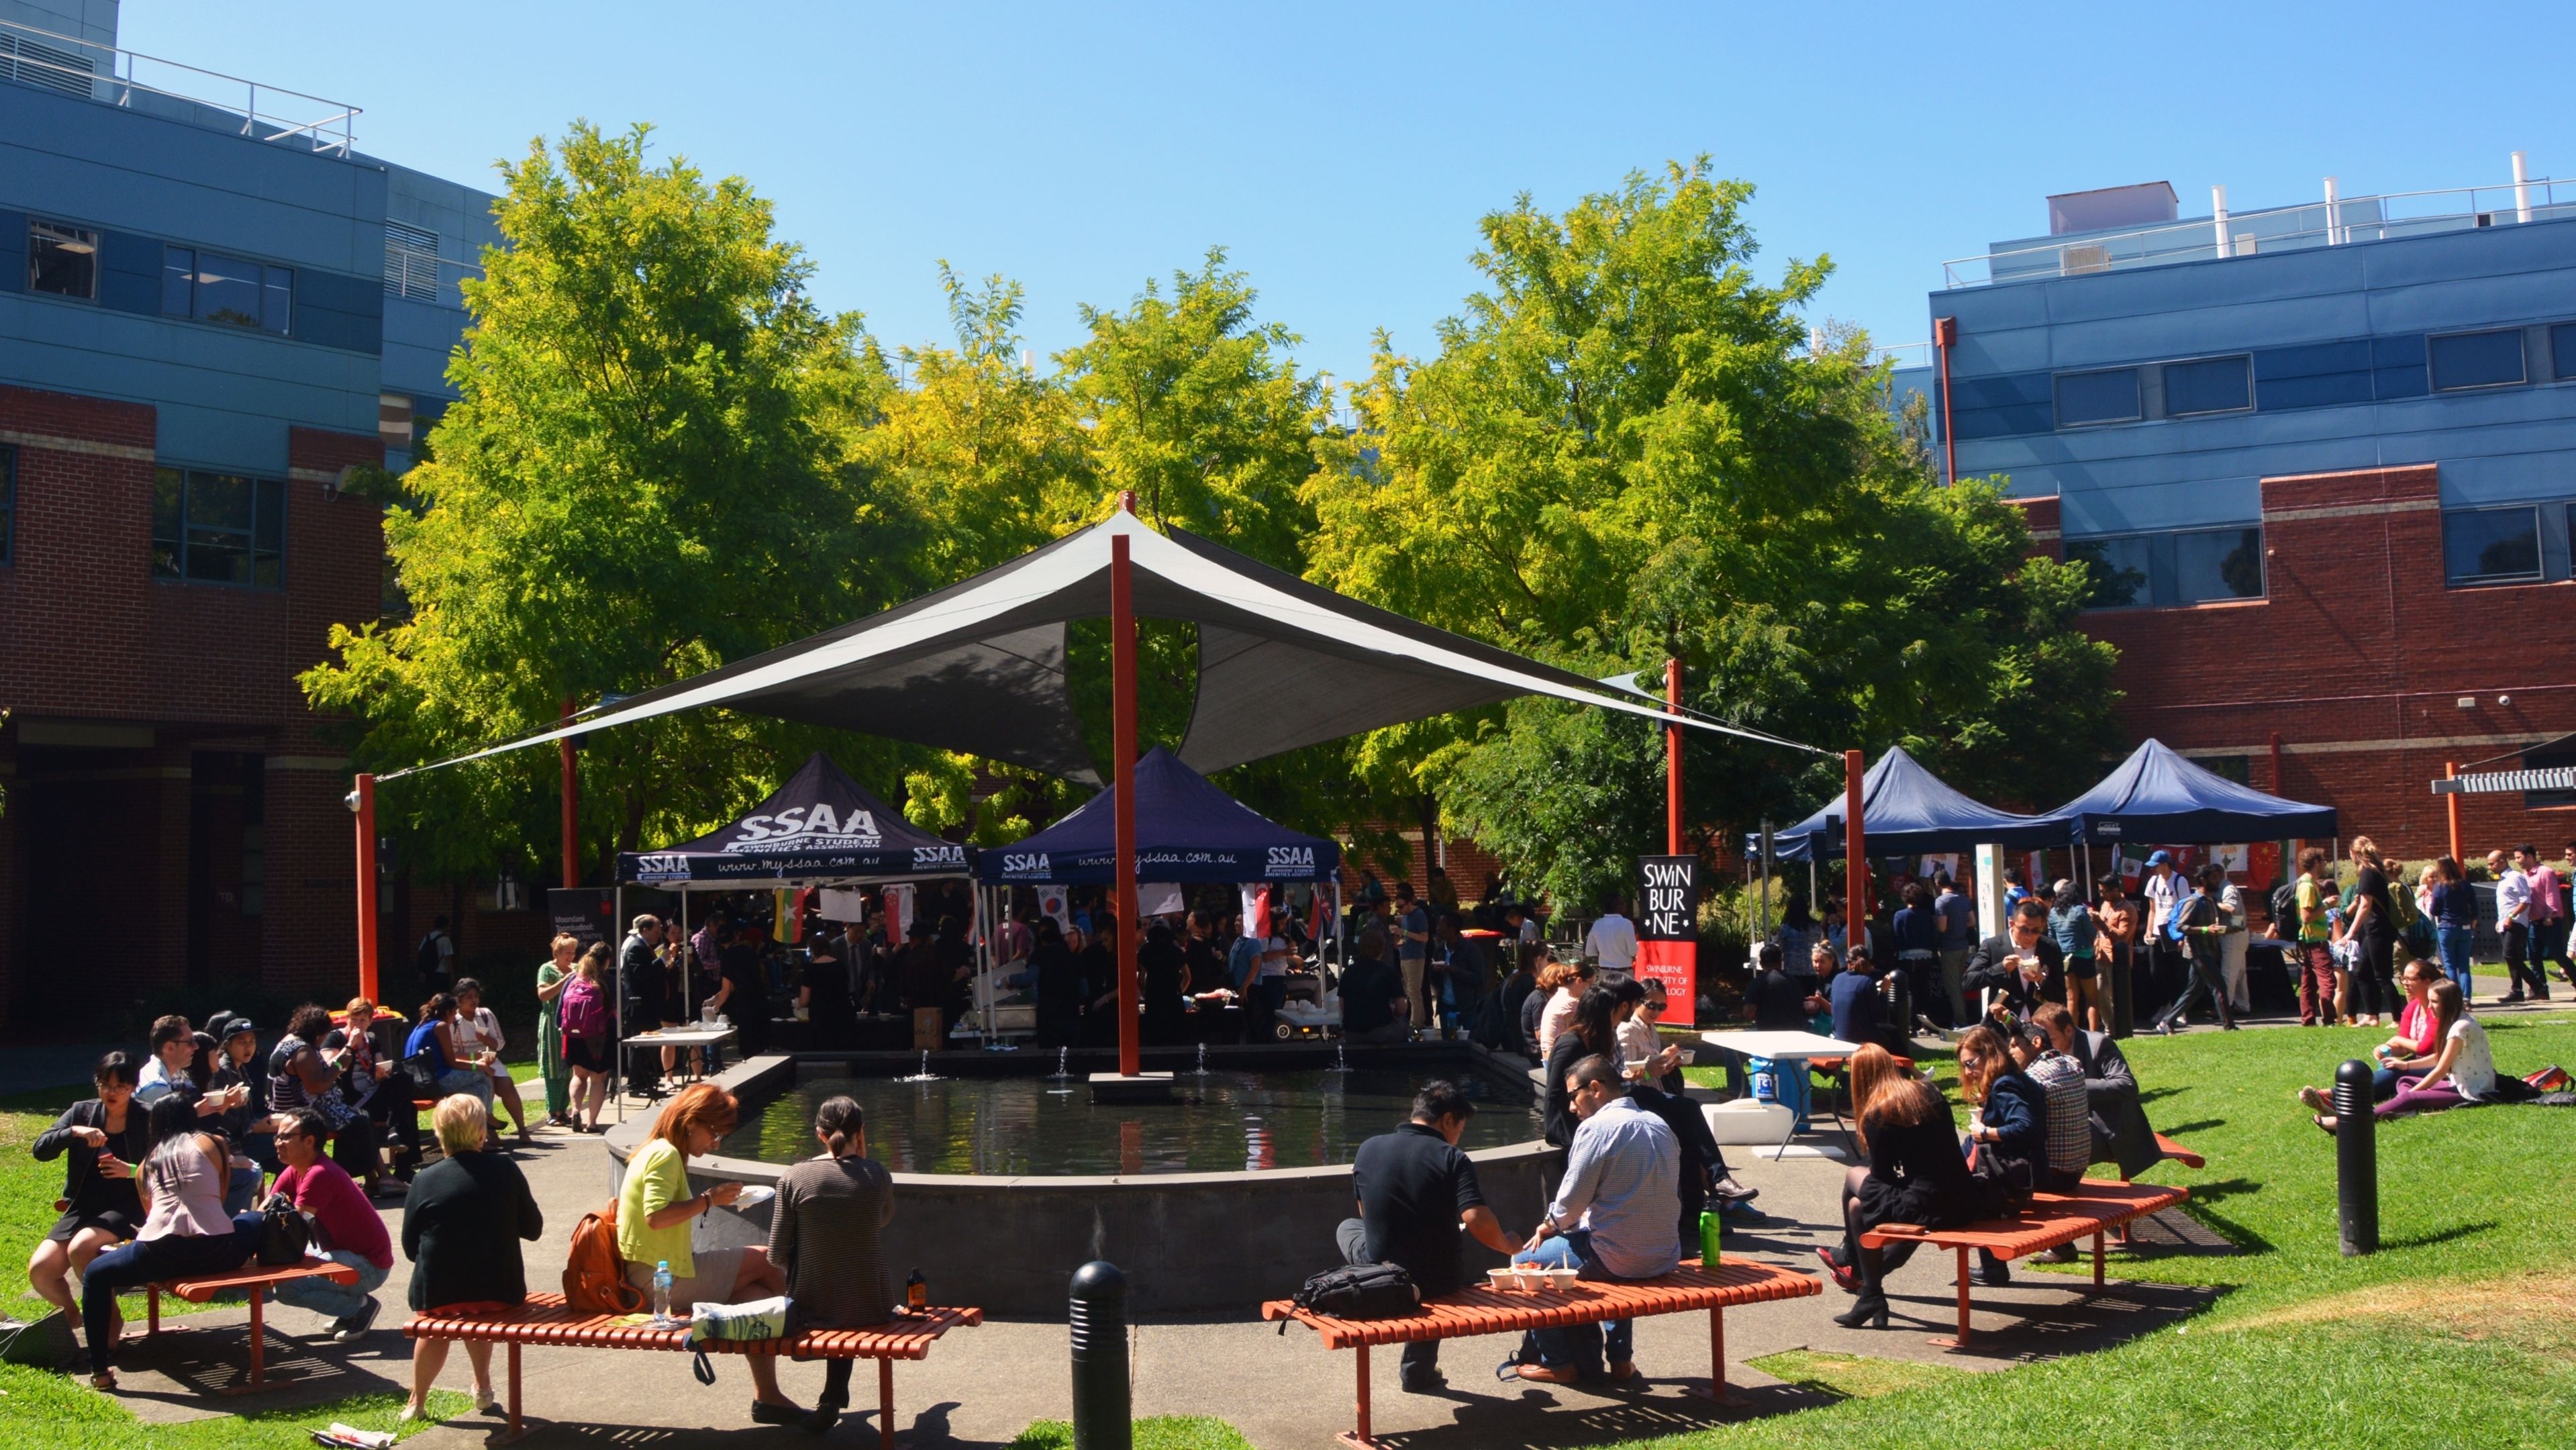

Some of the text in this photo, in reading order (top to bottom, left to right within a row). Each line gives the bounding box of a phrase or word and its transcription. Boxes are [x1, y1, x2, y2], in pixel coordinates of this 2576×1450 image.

[736, 804, 880, 841] SSAA
[721, 844, 801, 853] AMENITIES
[744, 837, 810, 851] SWINBURNE
[638, 855, 691, 873] SSAA
[913, 847, 965, 863] SSAA
[1003, 854, 1050, 872] SSAA
[1079, 852, 1238, 874] wwwyssaa.com.au
[1267, 847, 1315, 865] SSAA
[718, 857, 880, 879] www.myssaa.com.au
[1644, 864, 1691, 887] SWIN
[1650, 889, 1686, 911] BUR
[1653, 912, 1679, 934] NE
[1646, 965, 1683, 973] SWINBURNE
[1678, 977, 1688, 985] OF
